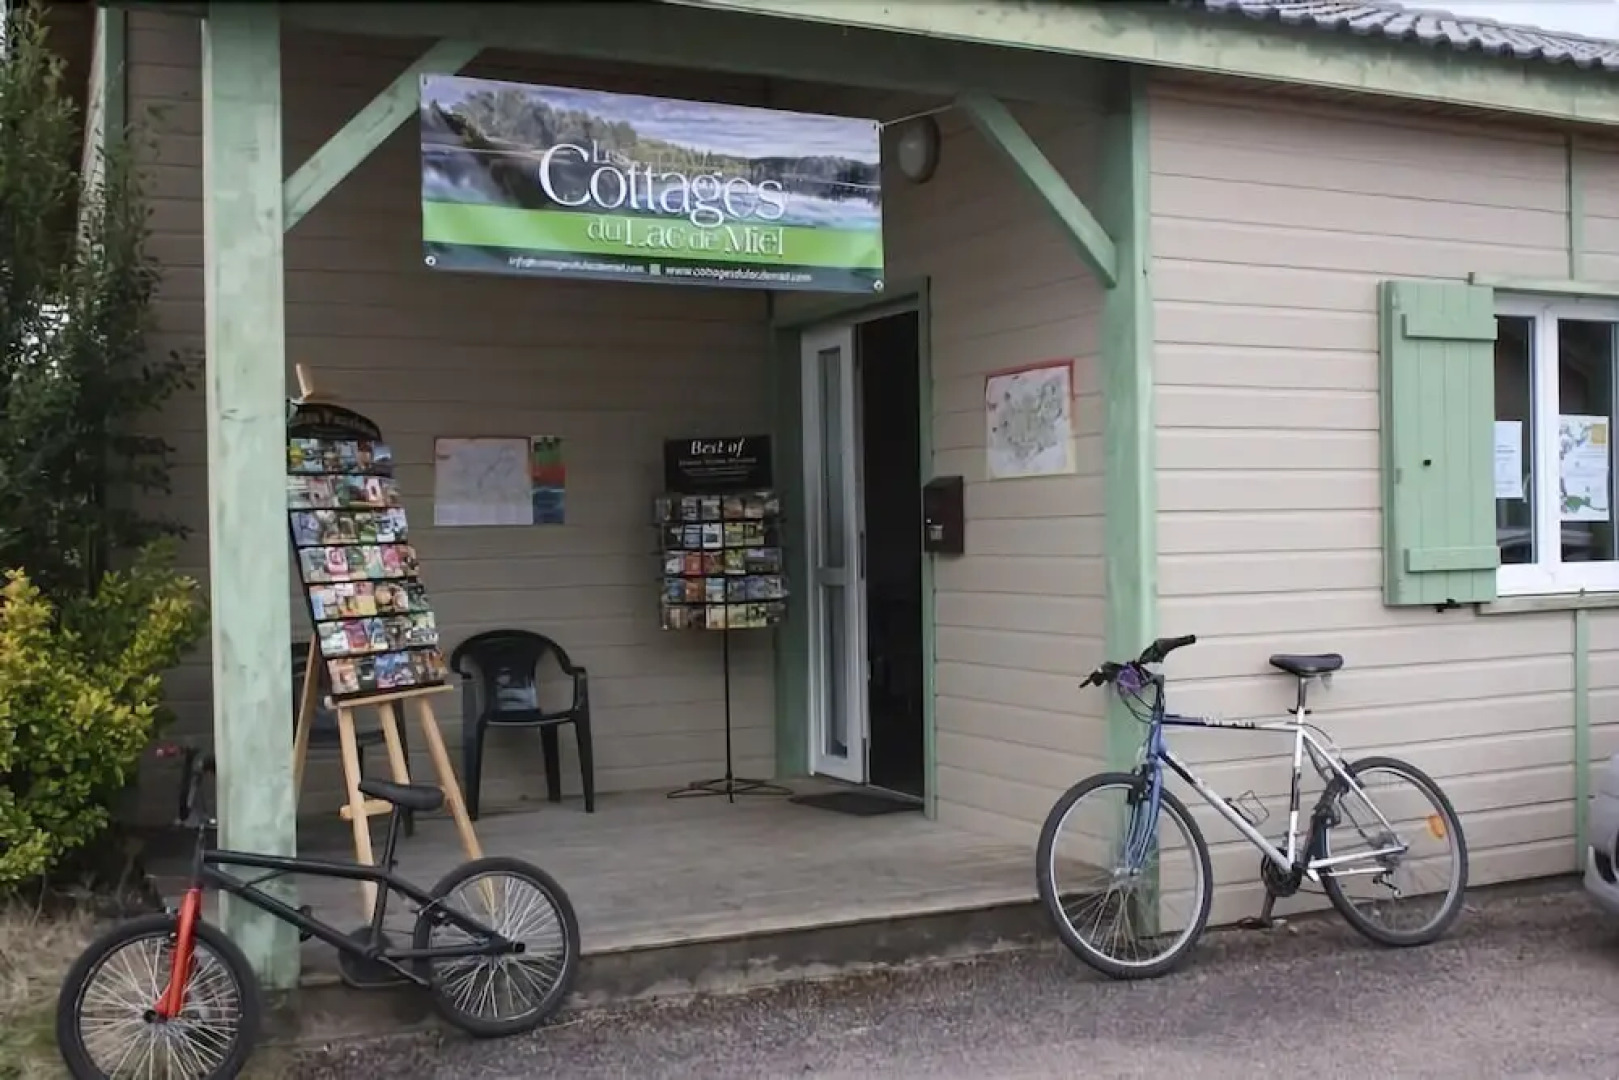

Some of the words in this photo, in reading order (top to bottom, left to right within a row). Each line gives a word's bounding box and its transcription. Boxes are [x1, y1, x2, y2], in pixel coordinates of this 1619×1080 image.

[539, 143, 785, 228] Cottages
[587, 218, 621, 240] du
[624, 219, 685, 250] Lac
[689, 232, 717, 251] de
[725, 226, 783, 257] Miel
[690, 440, 724, 456] Best
[727, 437, 745, 458] of
